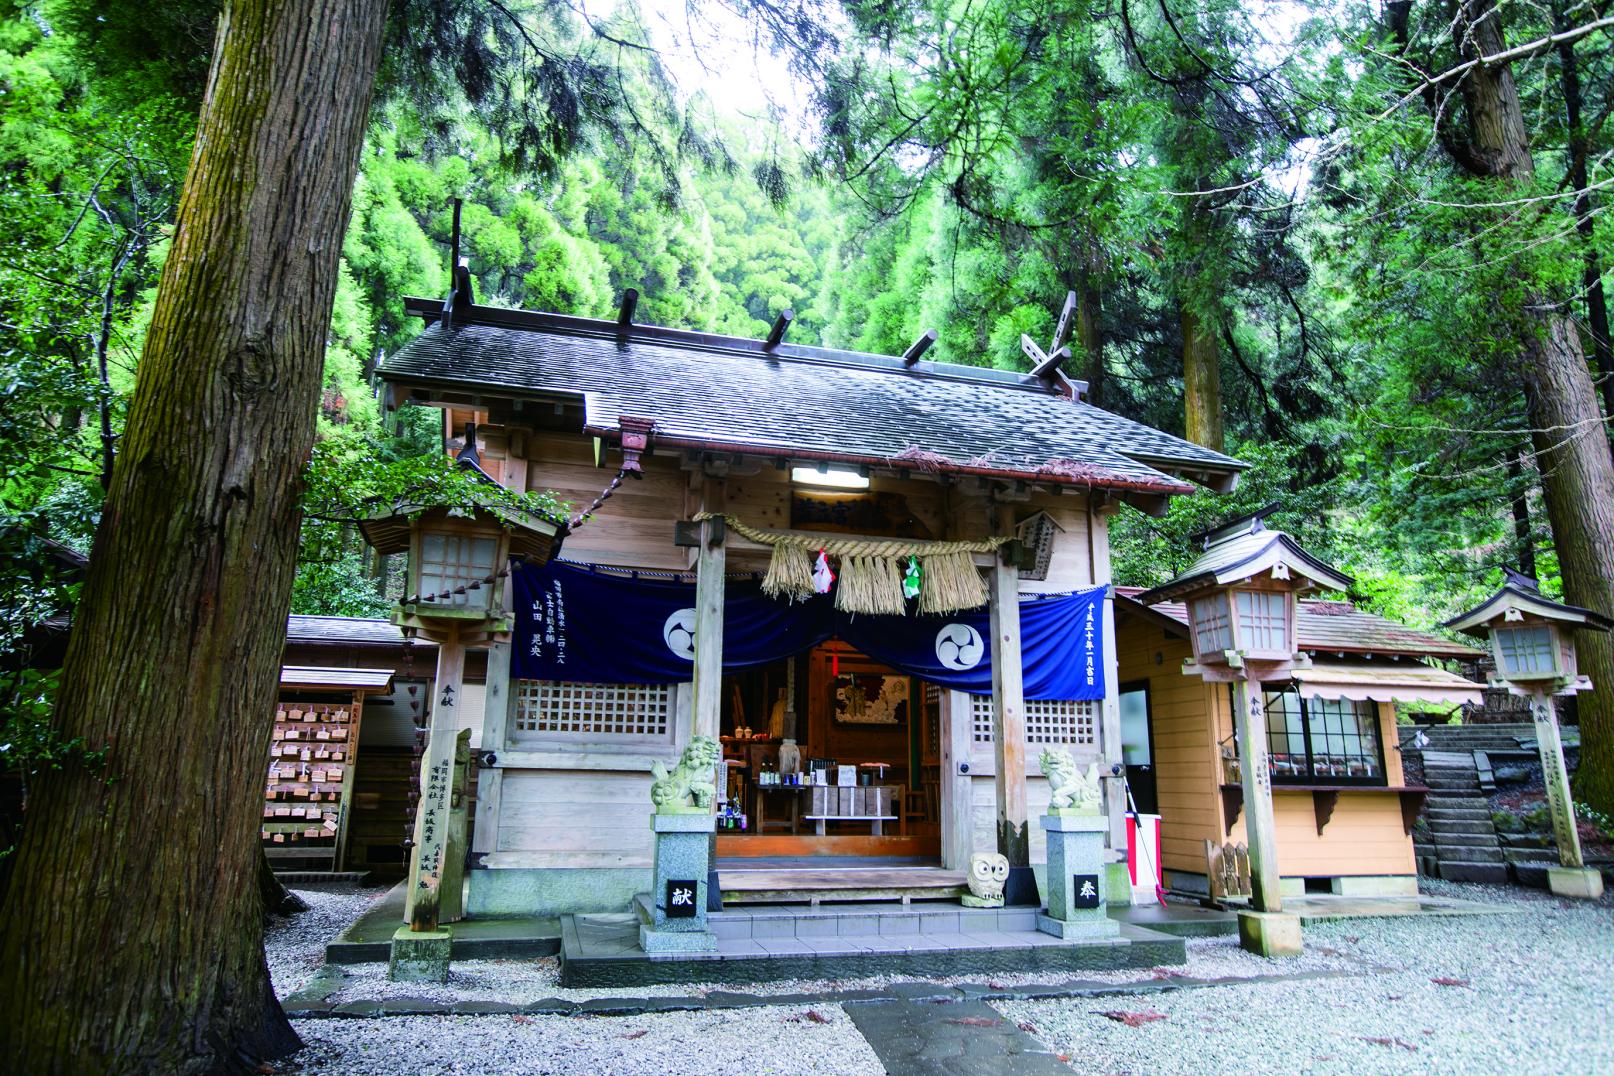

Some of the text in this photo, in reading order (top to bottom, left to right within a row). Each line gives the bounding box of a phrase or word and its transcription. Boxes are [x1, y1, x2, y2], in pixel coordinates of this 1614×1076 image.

[532, 600, 543, 622] 山田
[1084, 602, 1095, 686] 平成三十年一月吉日
[441, 684, 455, 707] 奉献
[1251, 696, 1261, 716] 奉献
[428, 766, 441, 799] 有限会社
[437, 759, 449, 810] 福岡市博多区
[672, 888, 693, 905] 献
[1080, 880, 1096, 900] 奉
